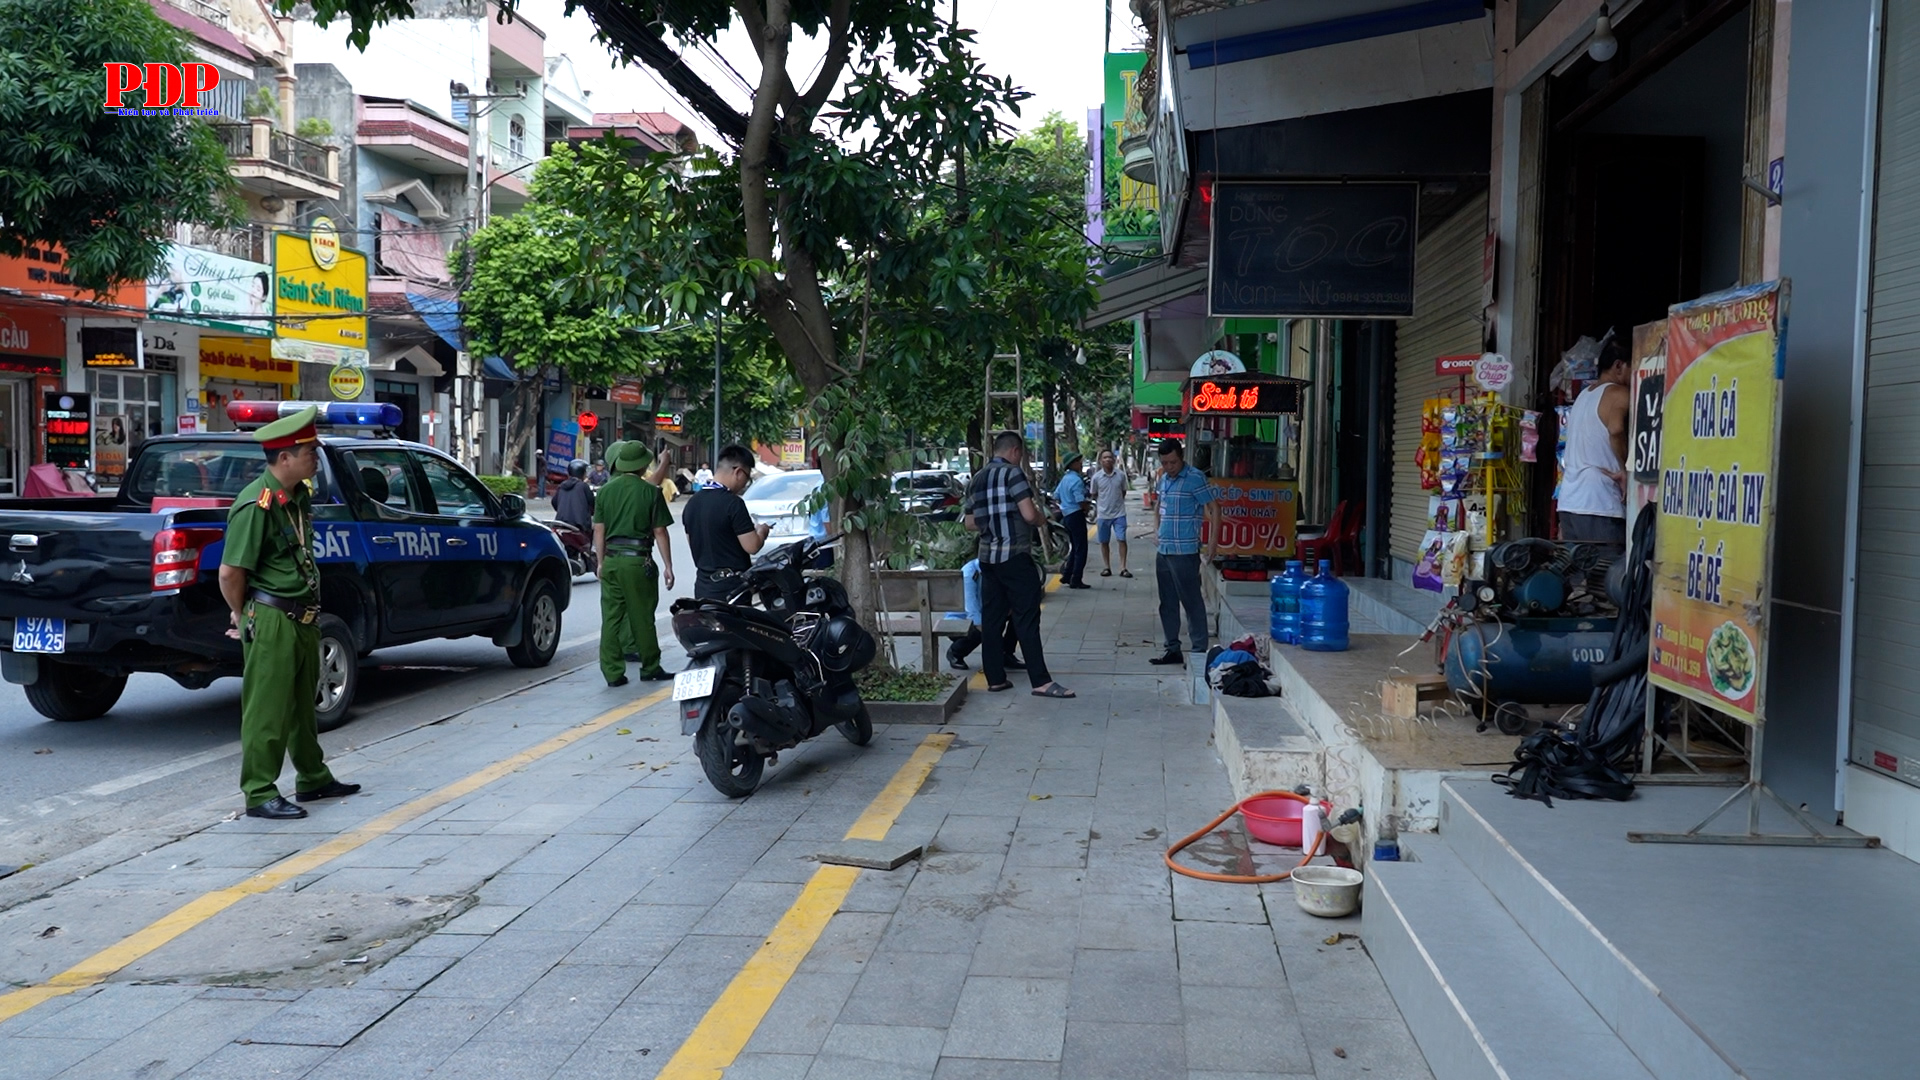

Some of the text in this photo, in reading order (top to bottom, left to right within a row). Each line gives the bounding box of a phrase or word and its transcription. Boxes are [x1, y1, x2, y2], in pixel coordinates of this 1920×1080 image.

[1228, 208, 1408, 277] TÓC
[279, 276, 308, 303] Bánh
[1221, 280, 1277, 306] Nam
[1479, 370, 1507, 382] Chups
[1480, 361, 1509, 372] Chupa
[1193, 382, 1260, 411] Sinh tố
[1693, 374, 1737, 438] CHẢ CÁ
[1249, 489, 1275, 503] SINH
[1663, 454, 1684, 515] CHẢ
[1687, 466, 1714, 529] MỰC
[1742, 473, 1765, 525] TAY
[312, 525, 498, 559] SÁT TRẬT TỰ
[1572, 648, 1604, 663] GOLD
